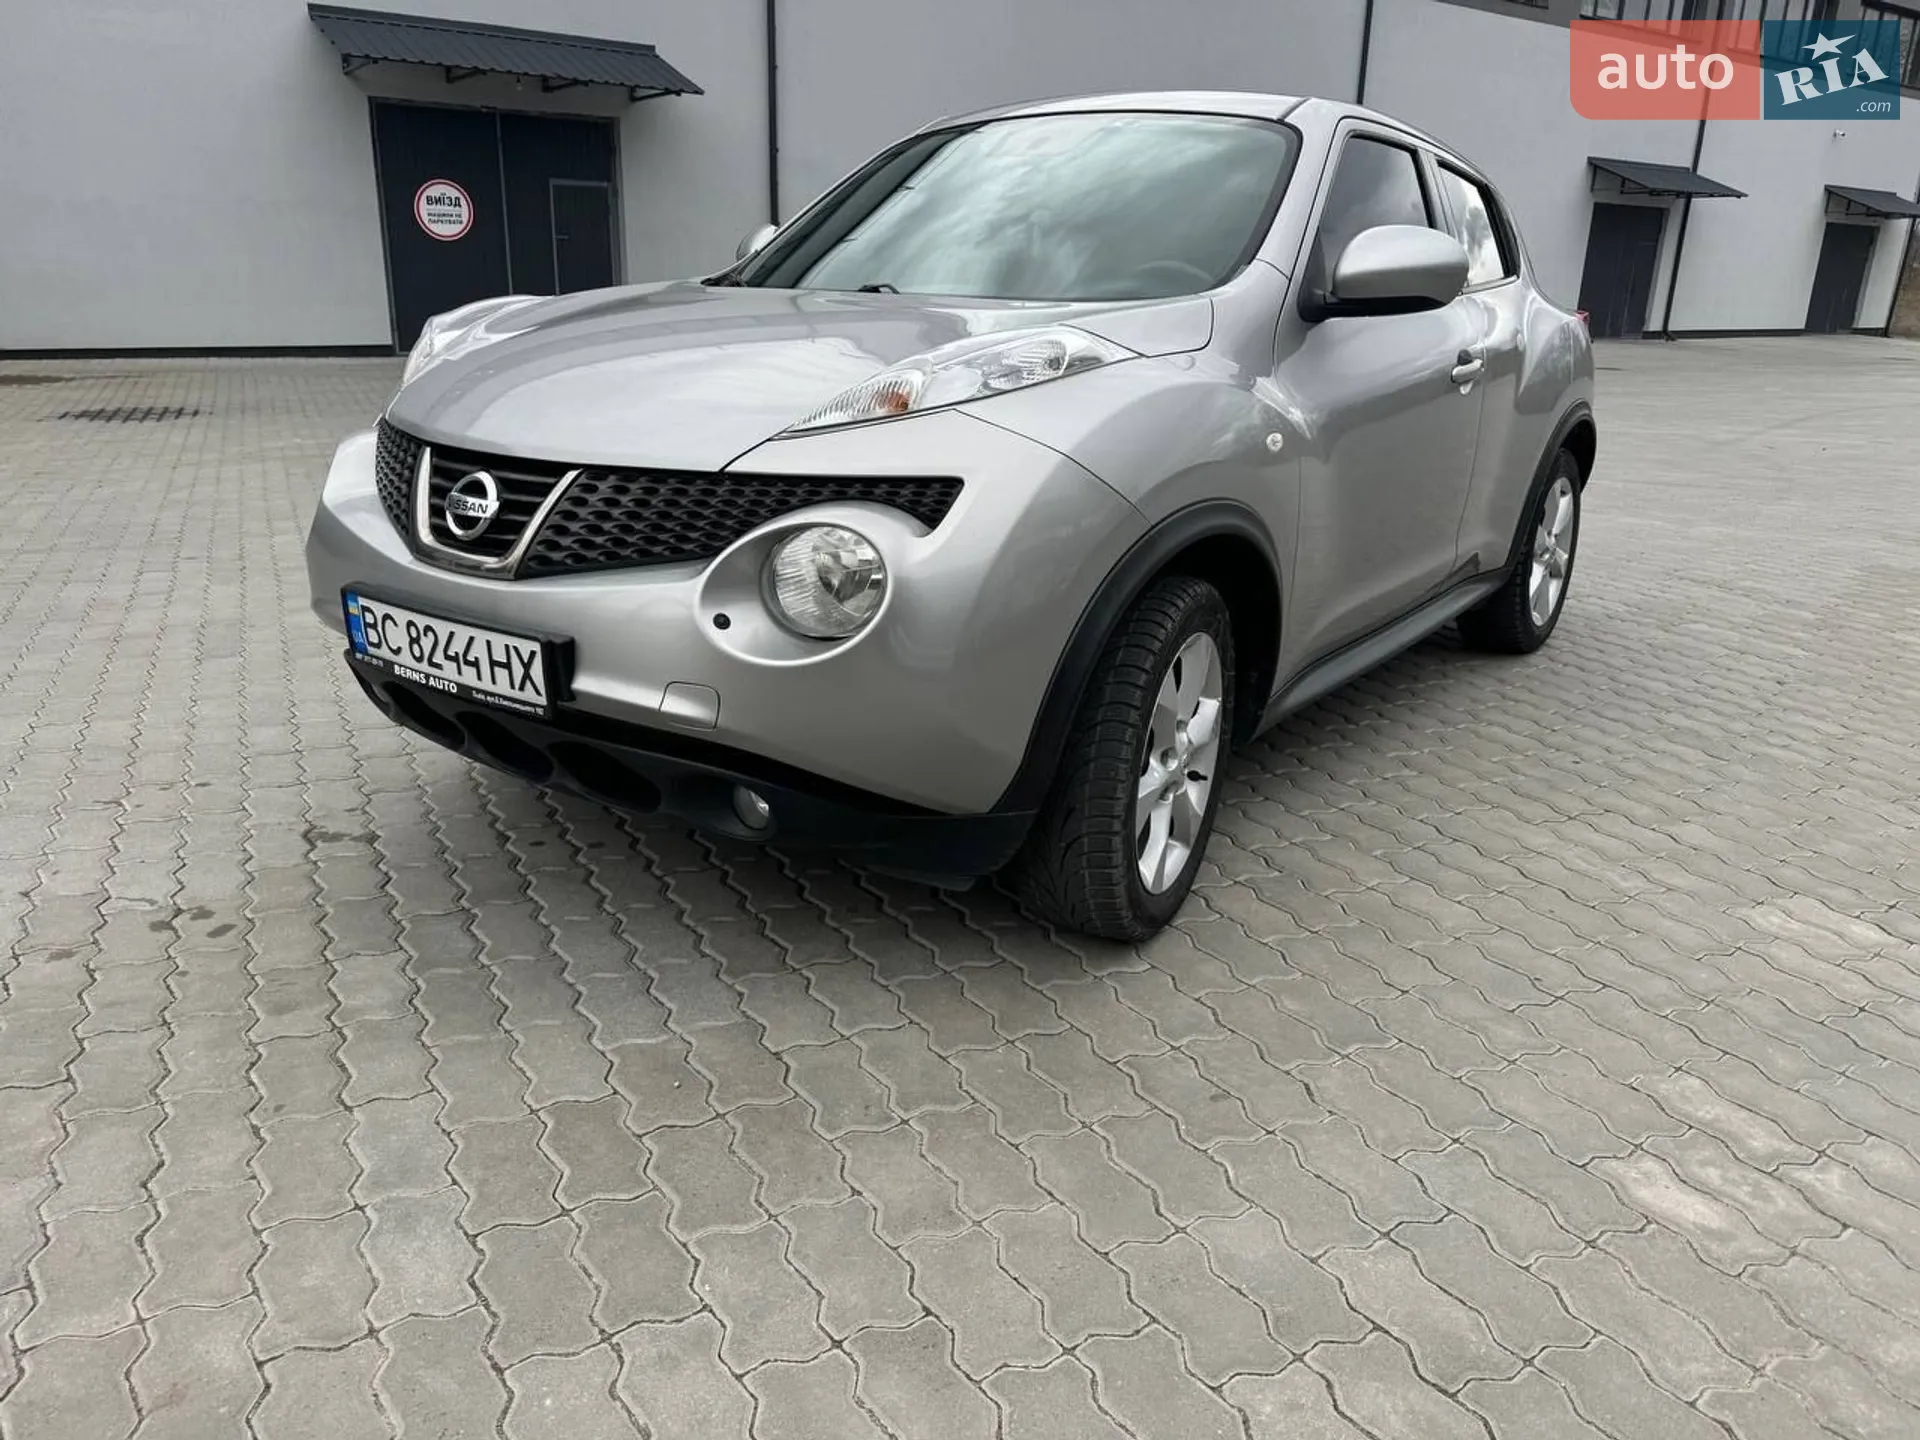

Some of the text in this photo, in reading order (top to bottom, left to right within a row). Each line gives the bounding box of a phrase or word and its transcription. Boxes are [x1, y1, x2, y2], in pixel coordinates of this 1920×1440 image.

[426, 192, 462, 208] ВИЇЗД
[394, 664, 458, 694] BERNS AUTO
